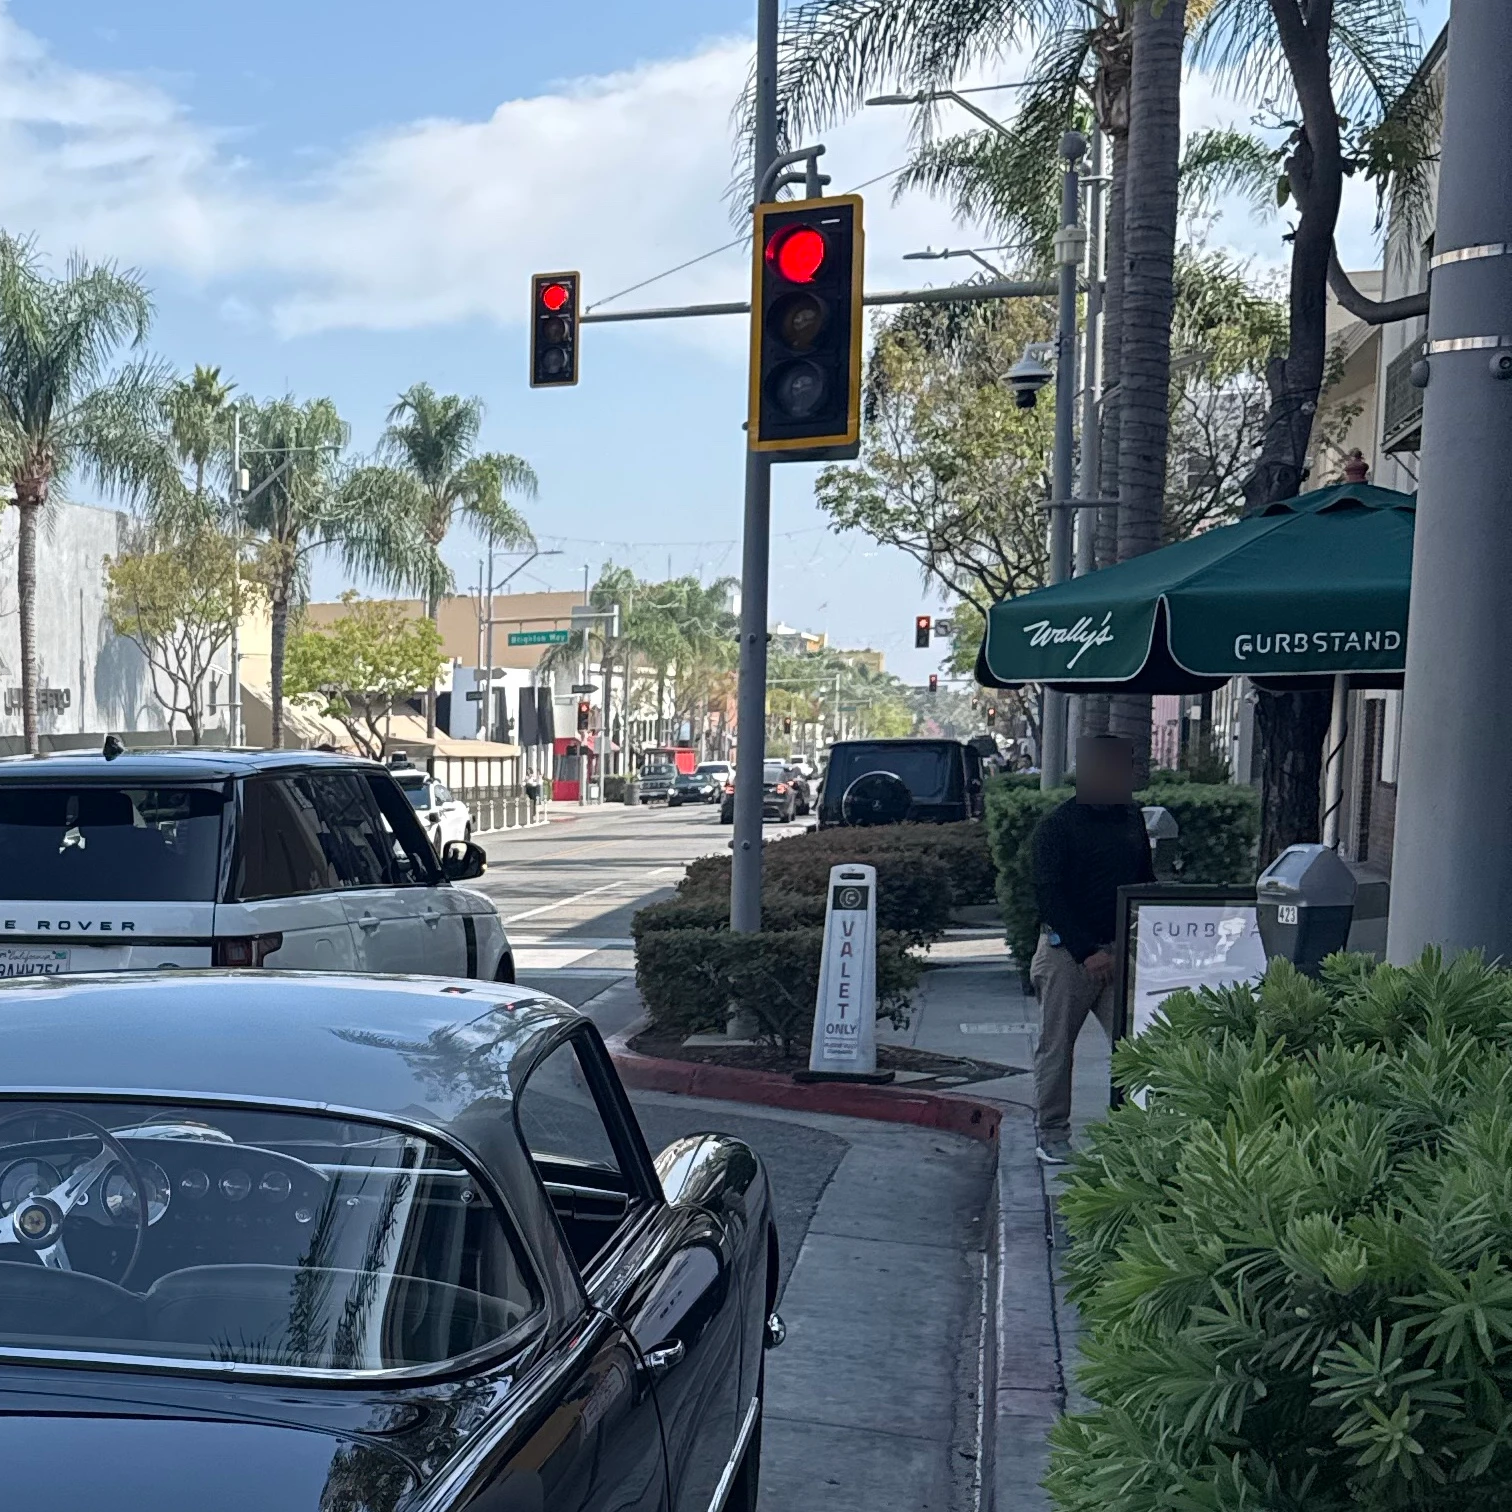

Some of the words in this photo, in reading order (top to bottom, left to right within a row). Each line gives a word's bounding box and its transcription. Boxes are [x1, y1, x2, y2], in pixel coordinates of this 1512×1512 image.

[549, 633, 566, 642] Way
[1023, 610, 1114, 669] Wally's
[1235, 631, 1401, 660] CURBSTAND
[1279, 906, 1297, 923] 423
[37, 920, 136, 931] ROVER
[8, 950, 52, 963] California
[838, 920, 855, 1020] VALET
[825, 1022, 857, 1035] ONLY
